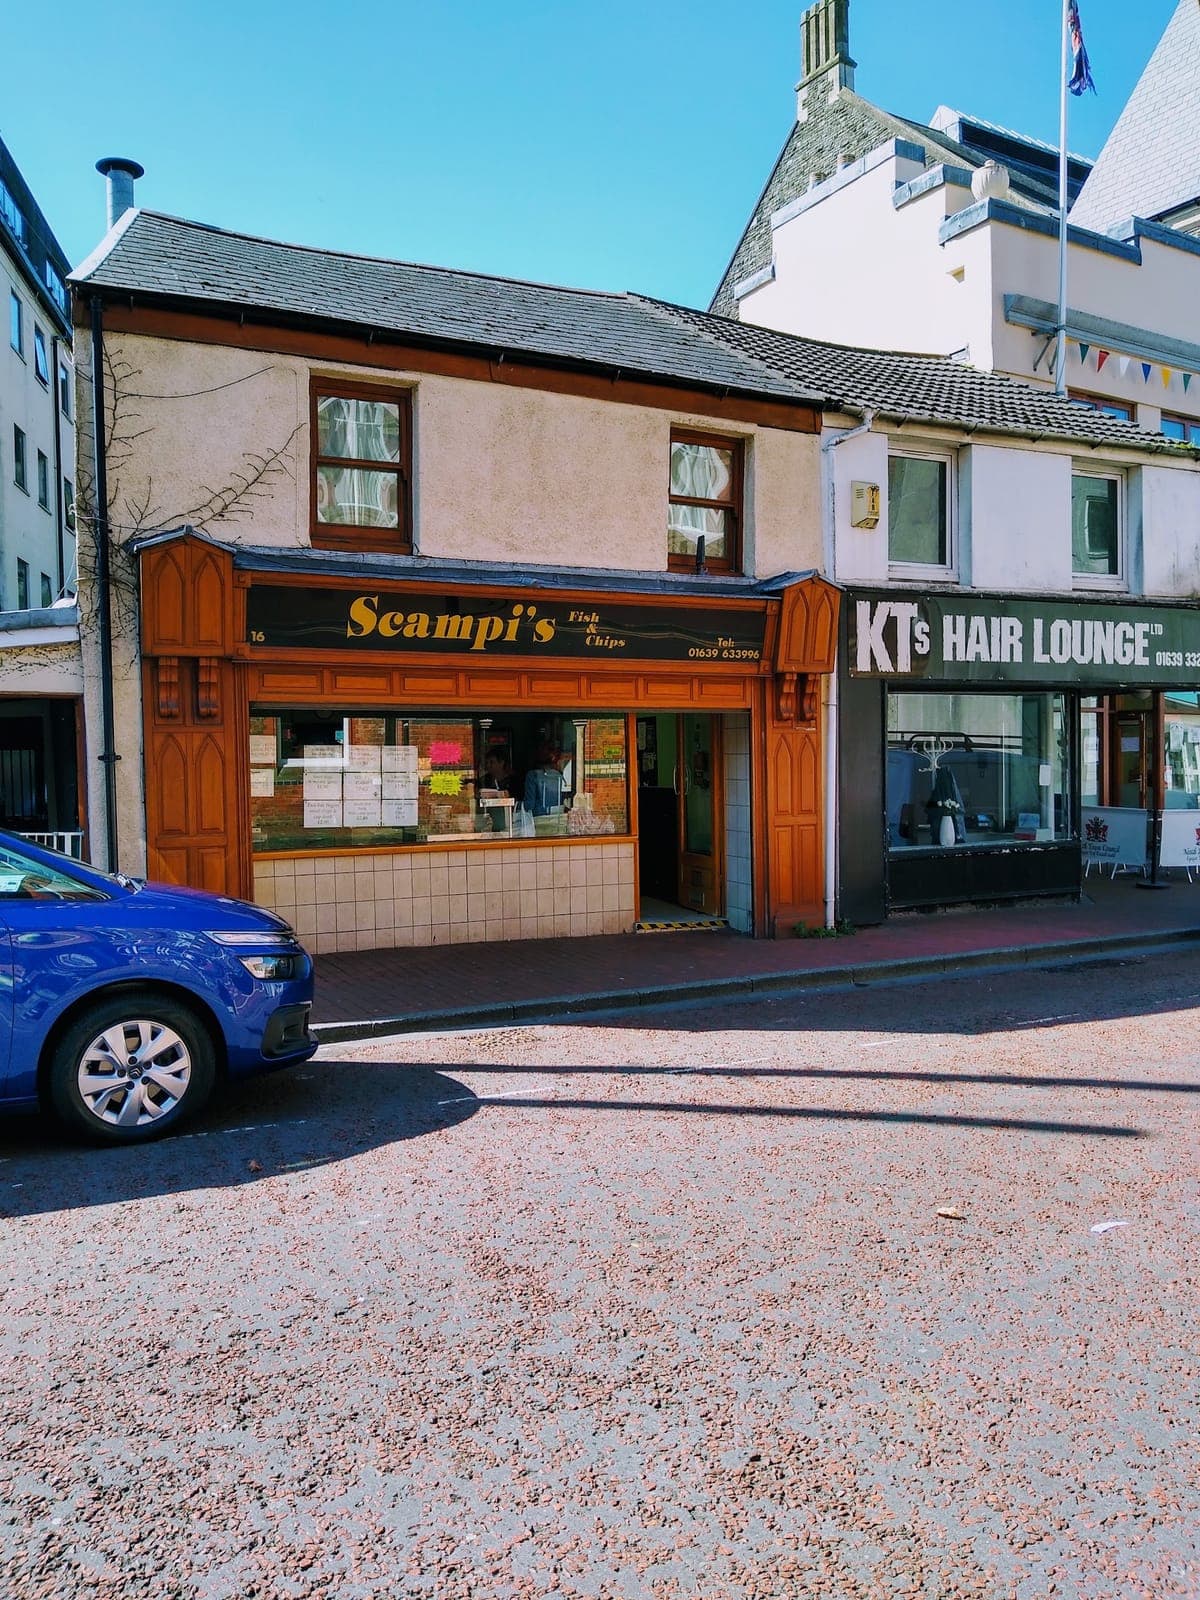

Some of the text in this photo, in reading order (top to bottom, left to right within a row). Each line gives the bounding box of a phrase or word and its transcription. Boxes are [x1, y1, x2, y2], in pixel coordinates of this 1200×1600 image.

[347, 595, 556, 650] Scampi's
[568, 611, 600, 623] Fish
[586, 623, 598, 634] &
[250, 630, 266, 642] 16
[585, 635, 626, 649] Chips
[942, 614, 1023, 663] HAIR
[1033, 618, 1149, 665] LOUNGE
[1150, 623, 1163, 635] LTD
[717, 637, 735, 648] Tel:
[688, 647, 760, 659] 01639 633996
[1156, 651, 1183, 666] 01639
